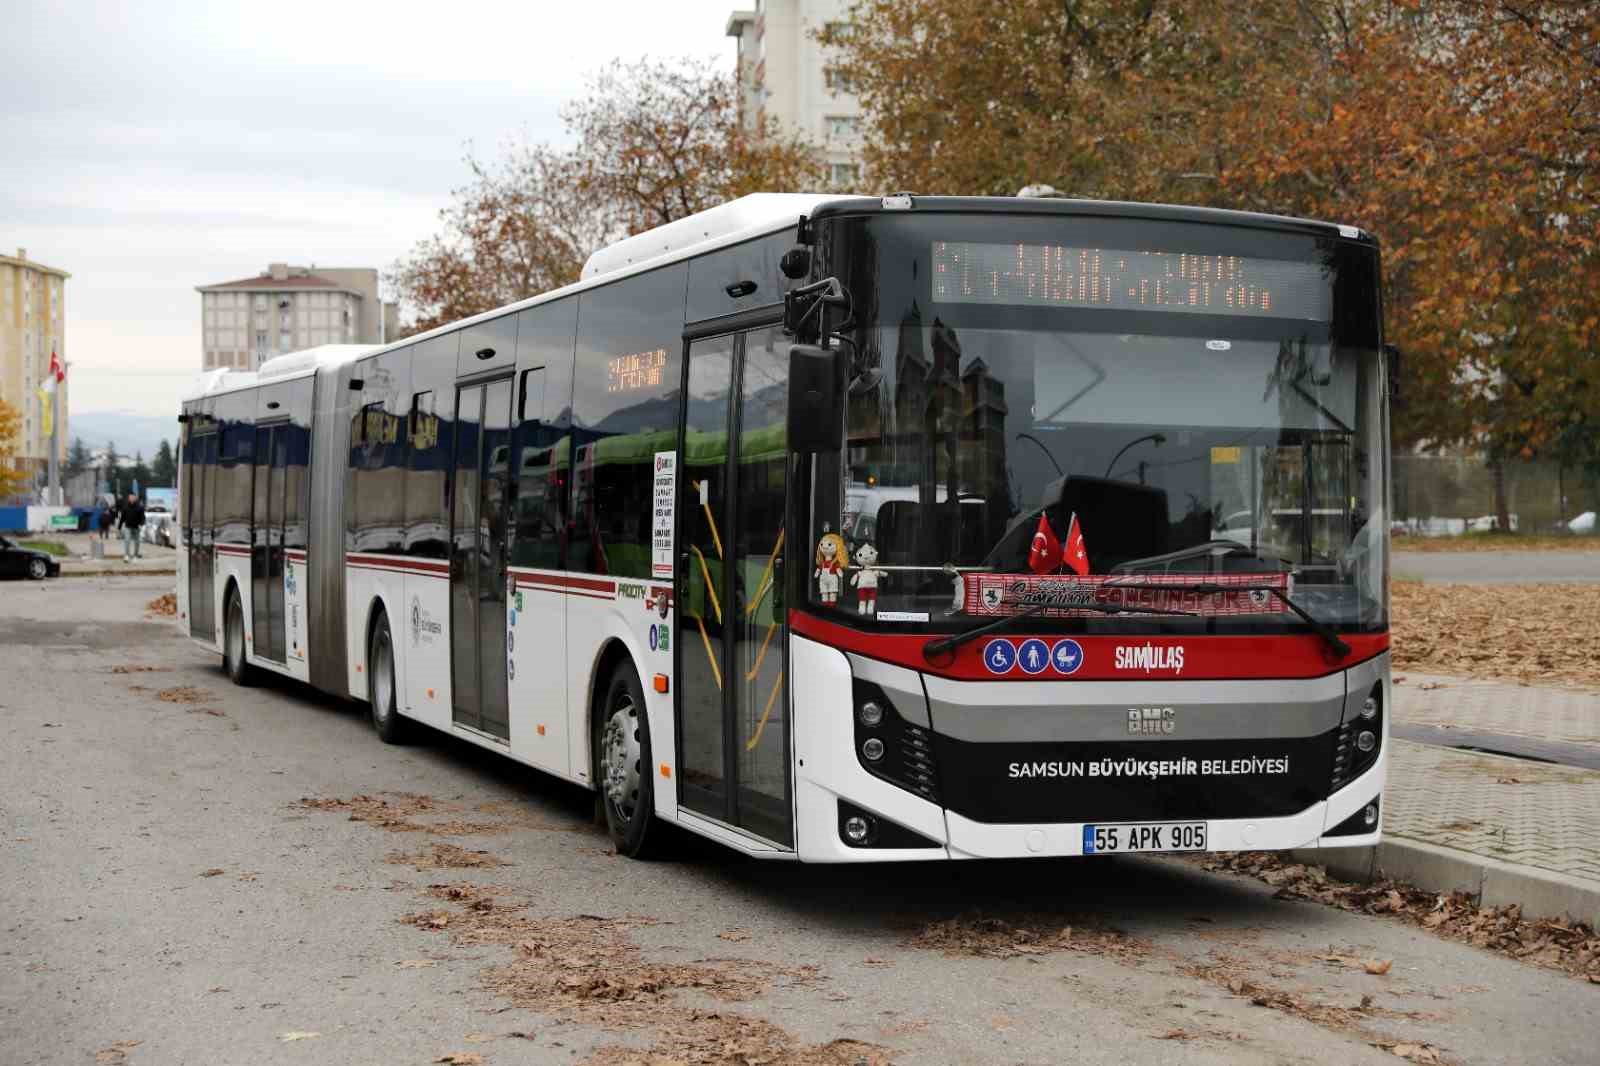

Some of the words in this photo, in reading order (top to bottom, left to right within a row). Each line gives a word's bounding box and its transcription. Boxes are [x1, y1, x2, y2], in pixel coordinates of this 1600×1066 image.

[1127, 707, 1176, 736] BMC
[1008, 762, 1085, 778] SAMSUN
[1088, 757, 1198, 780] BÜYÜKŞEHİR
[1201, 755, 1289, 775] BELEDİYESİ
[1095, 828, 1118, 850] 55
[1128, 827, 1162, 849] APK
[1171, 825, 1204, 848] 905
